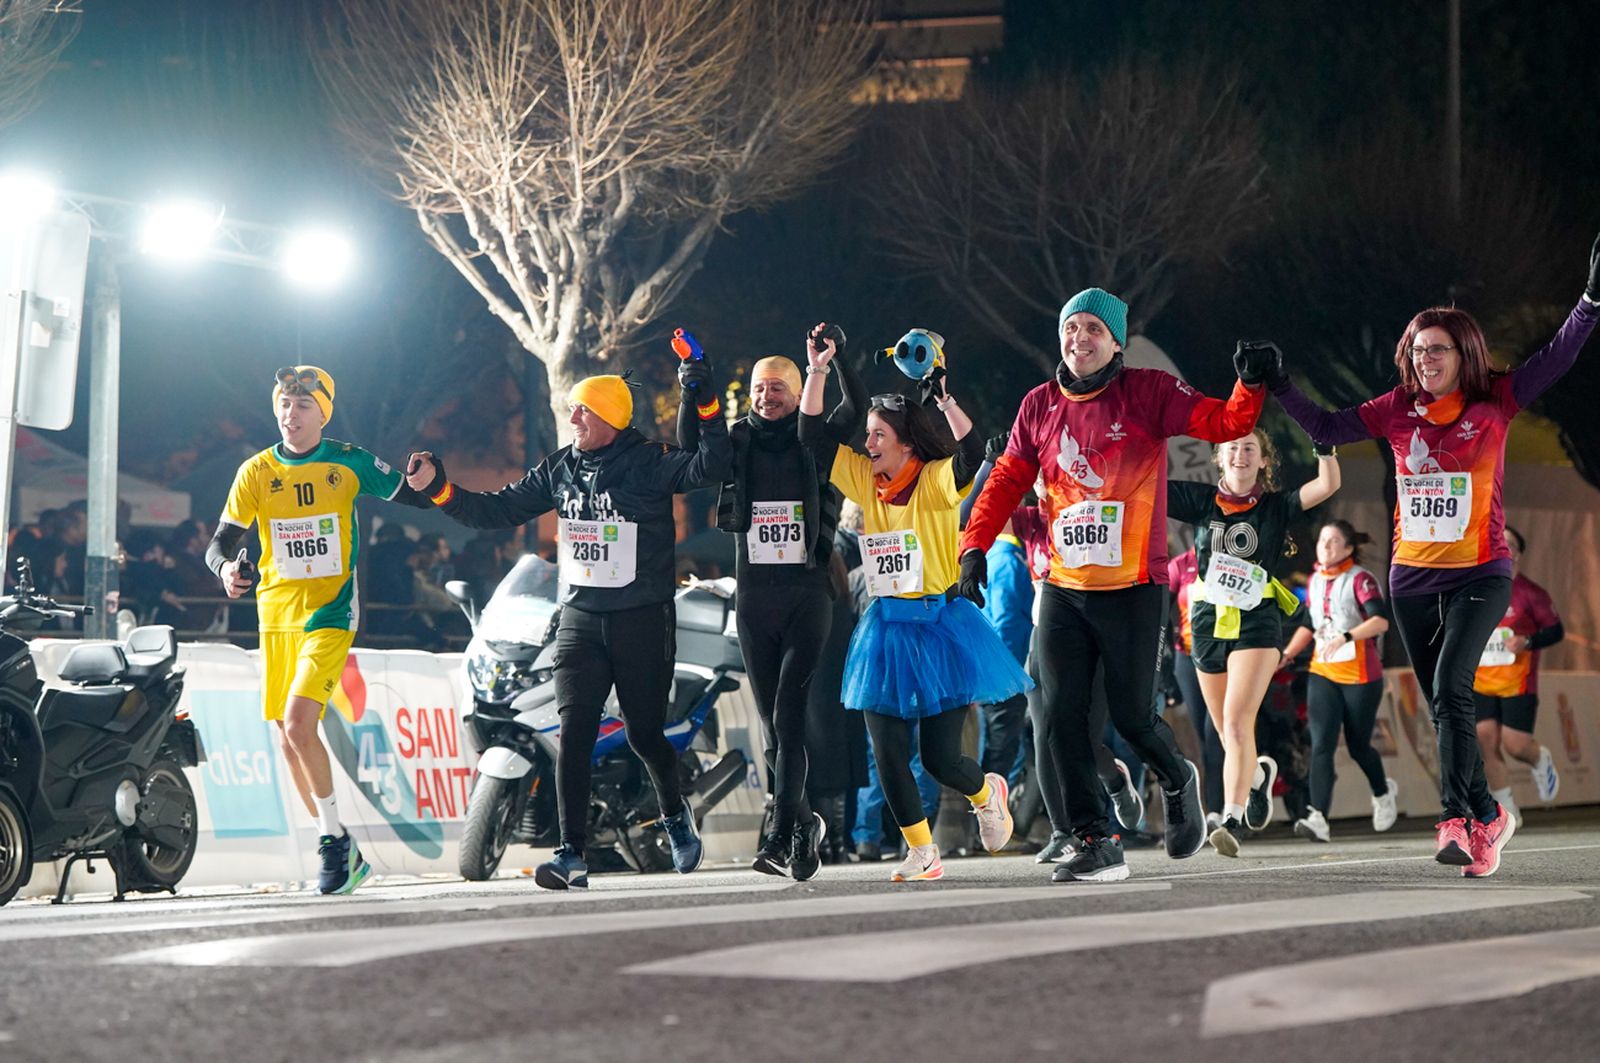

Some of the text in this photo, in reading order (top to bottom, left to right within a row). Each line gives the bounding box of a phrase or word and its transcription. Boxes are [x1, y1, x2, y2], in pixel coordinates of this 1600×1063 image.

[1070, 460, 1088, 479] 43
[293, 482, 314, 507] 10
[1407, 488, 1420, 496] SAN
[284, 524, 304, 532] NOCHE
[752, 516, 765, 524] SAN
[278, 532, 291, 540] SAN
[758, 523, 800, 544] 6873
[1062, 524, 1108, 546] 5868
[285, 537, 328, 558] 1866
[572, 542, 609, 562] 2361
[868, 548, 881, 556] SAN
[876, 552, 911, 575] 2361
[1215, 564, 1228, 572] SAN
[1217, 572, 1253, 595] 4572
[396, 707, 458, 760] SAN
[207, 744, 272, 786] alsa
[358, 732, 401, 815] 43
[416, 767, 479, 819] ANT
